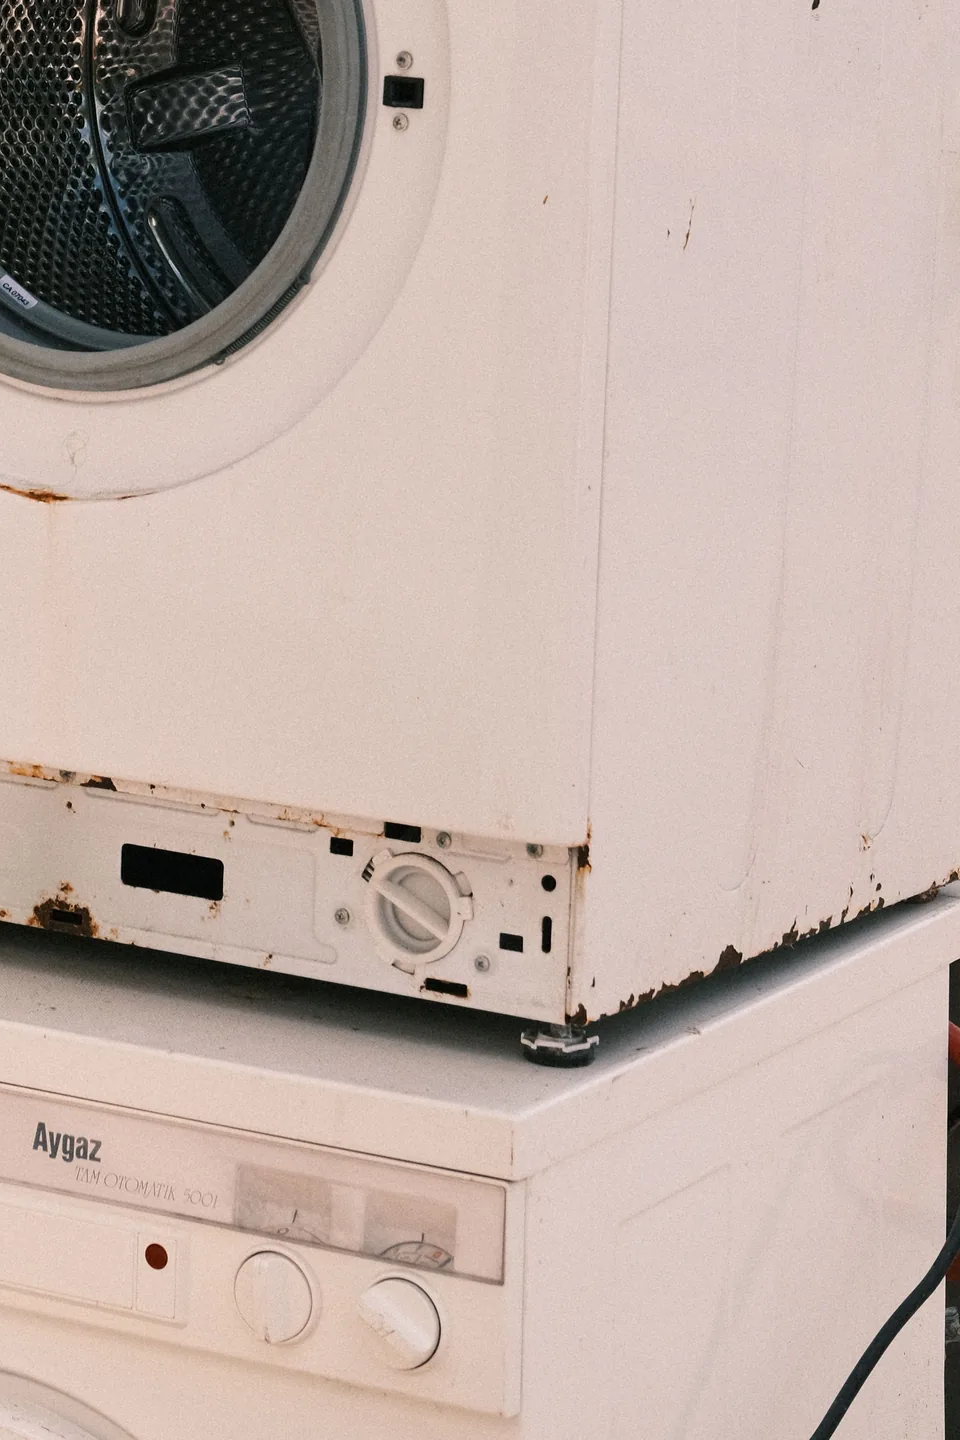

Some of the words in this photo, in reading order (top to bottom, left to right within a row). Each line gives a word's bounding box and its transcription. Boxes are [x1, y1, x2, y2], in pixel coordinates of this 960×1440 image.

[32, 1122, 102, 1163] Aygaz
[75, 1165, 101, 1185] TAM
[183, 1188, 219, 1209] 5001
